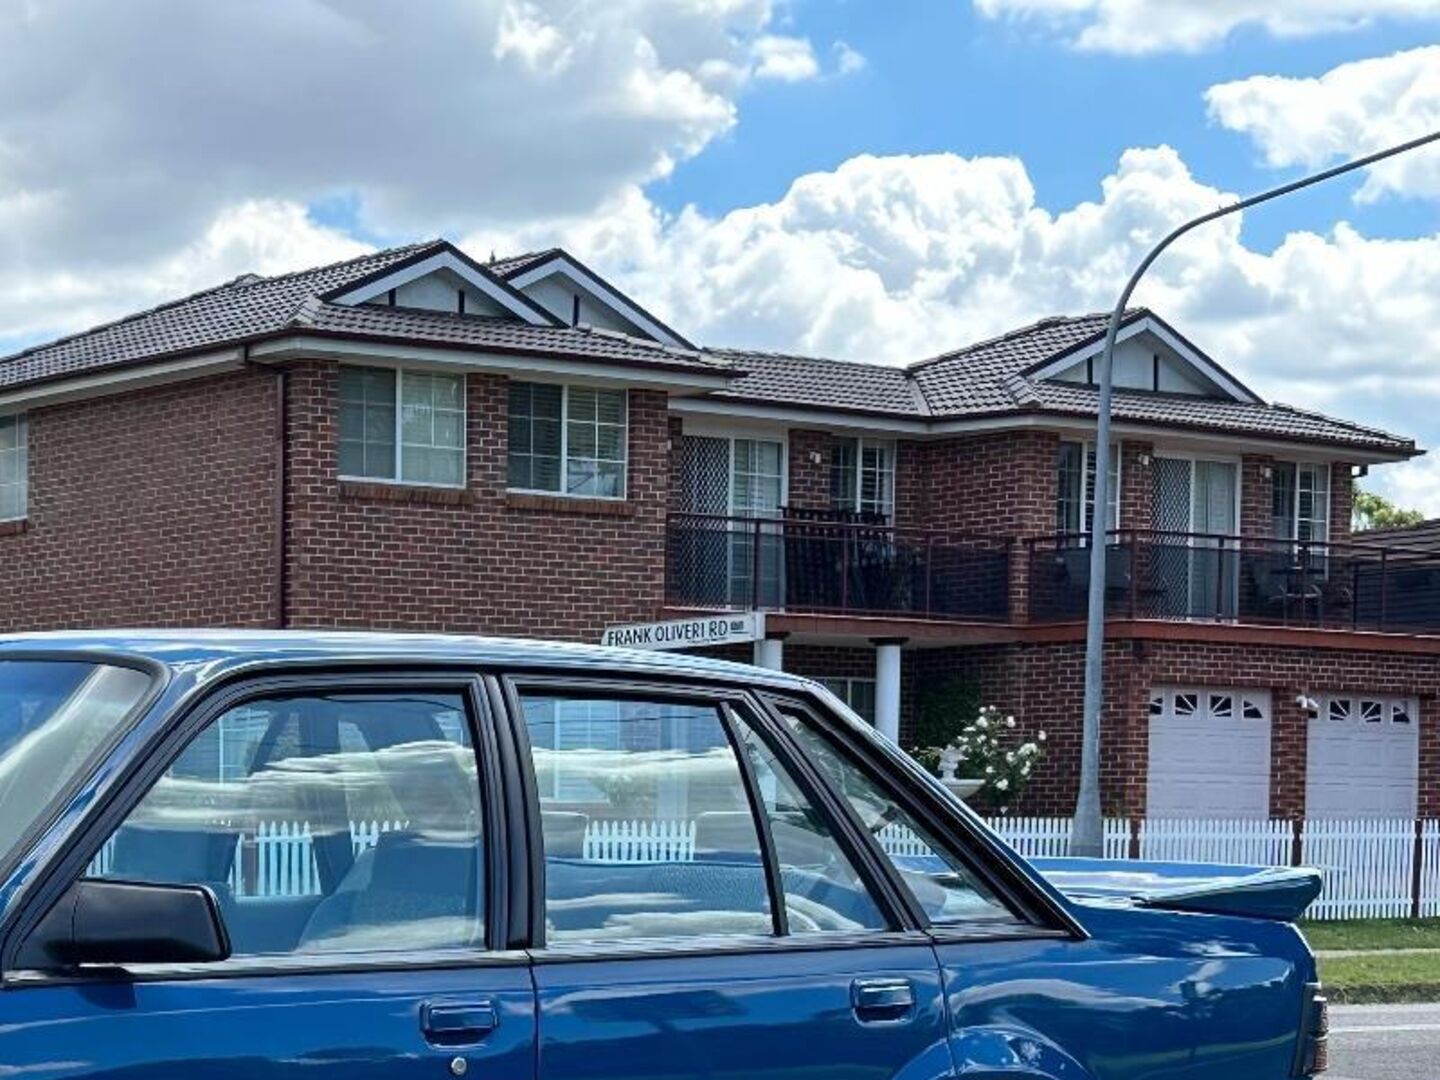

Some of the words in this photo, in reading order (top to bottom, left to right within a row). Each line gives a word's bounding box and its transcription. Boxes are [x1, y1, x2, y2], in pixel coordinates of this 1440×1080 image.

[607, 628, 652, 647] FRANK
[655, 622, 705, 642] OLIVERI
[709, 620, 728, 637] RD
